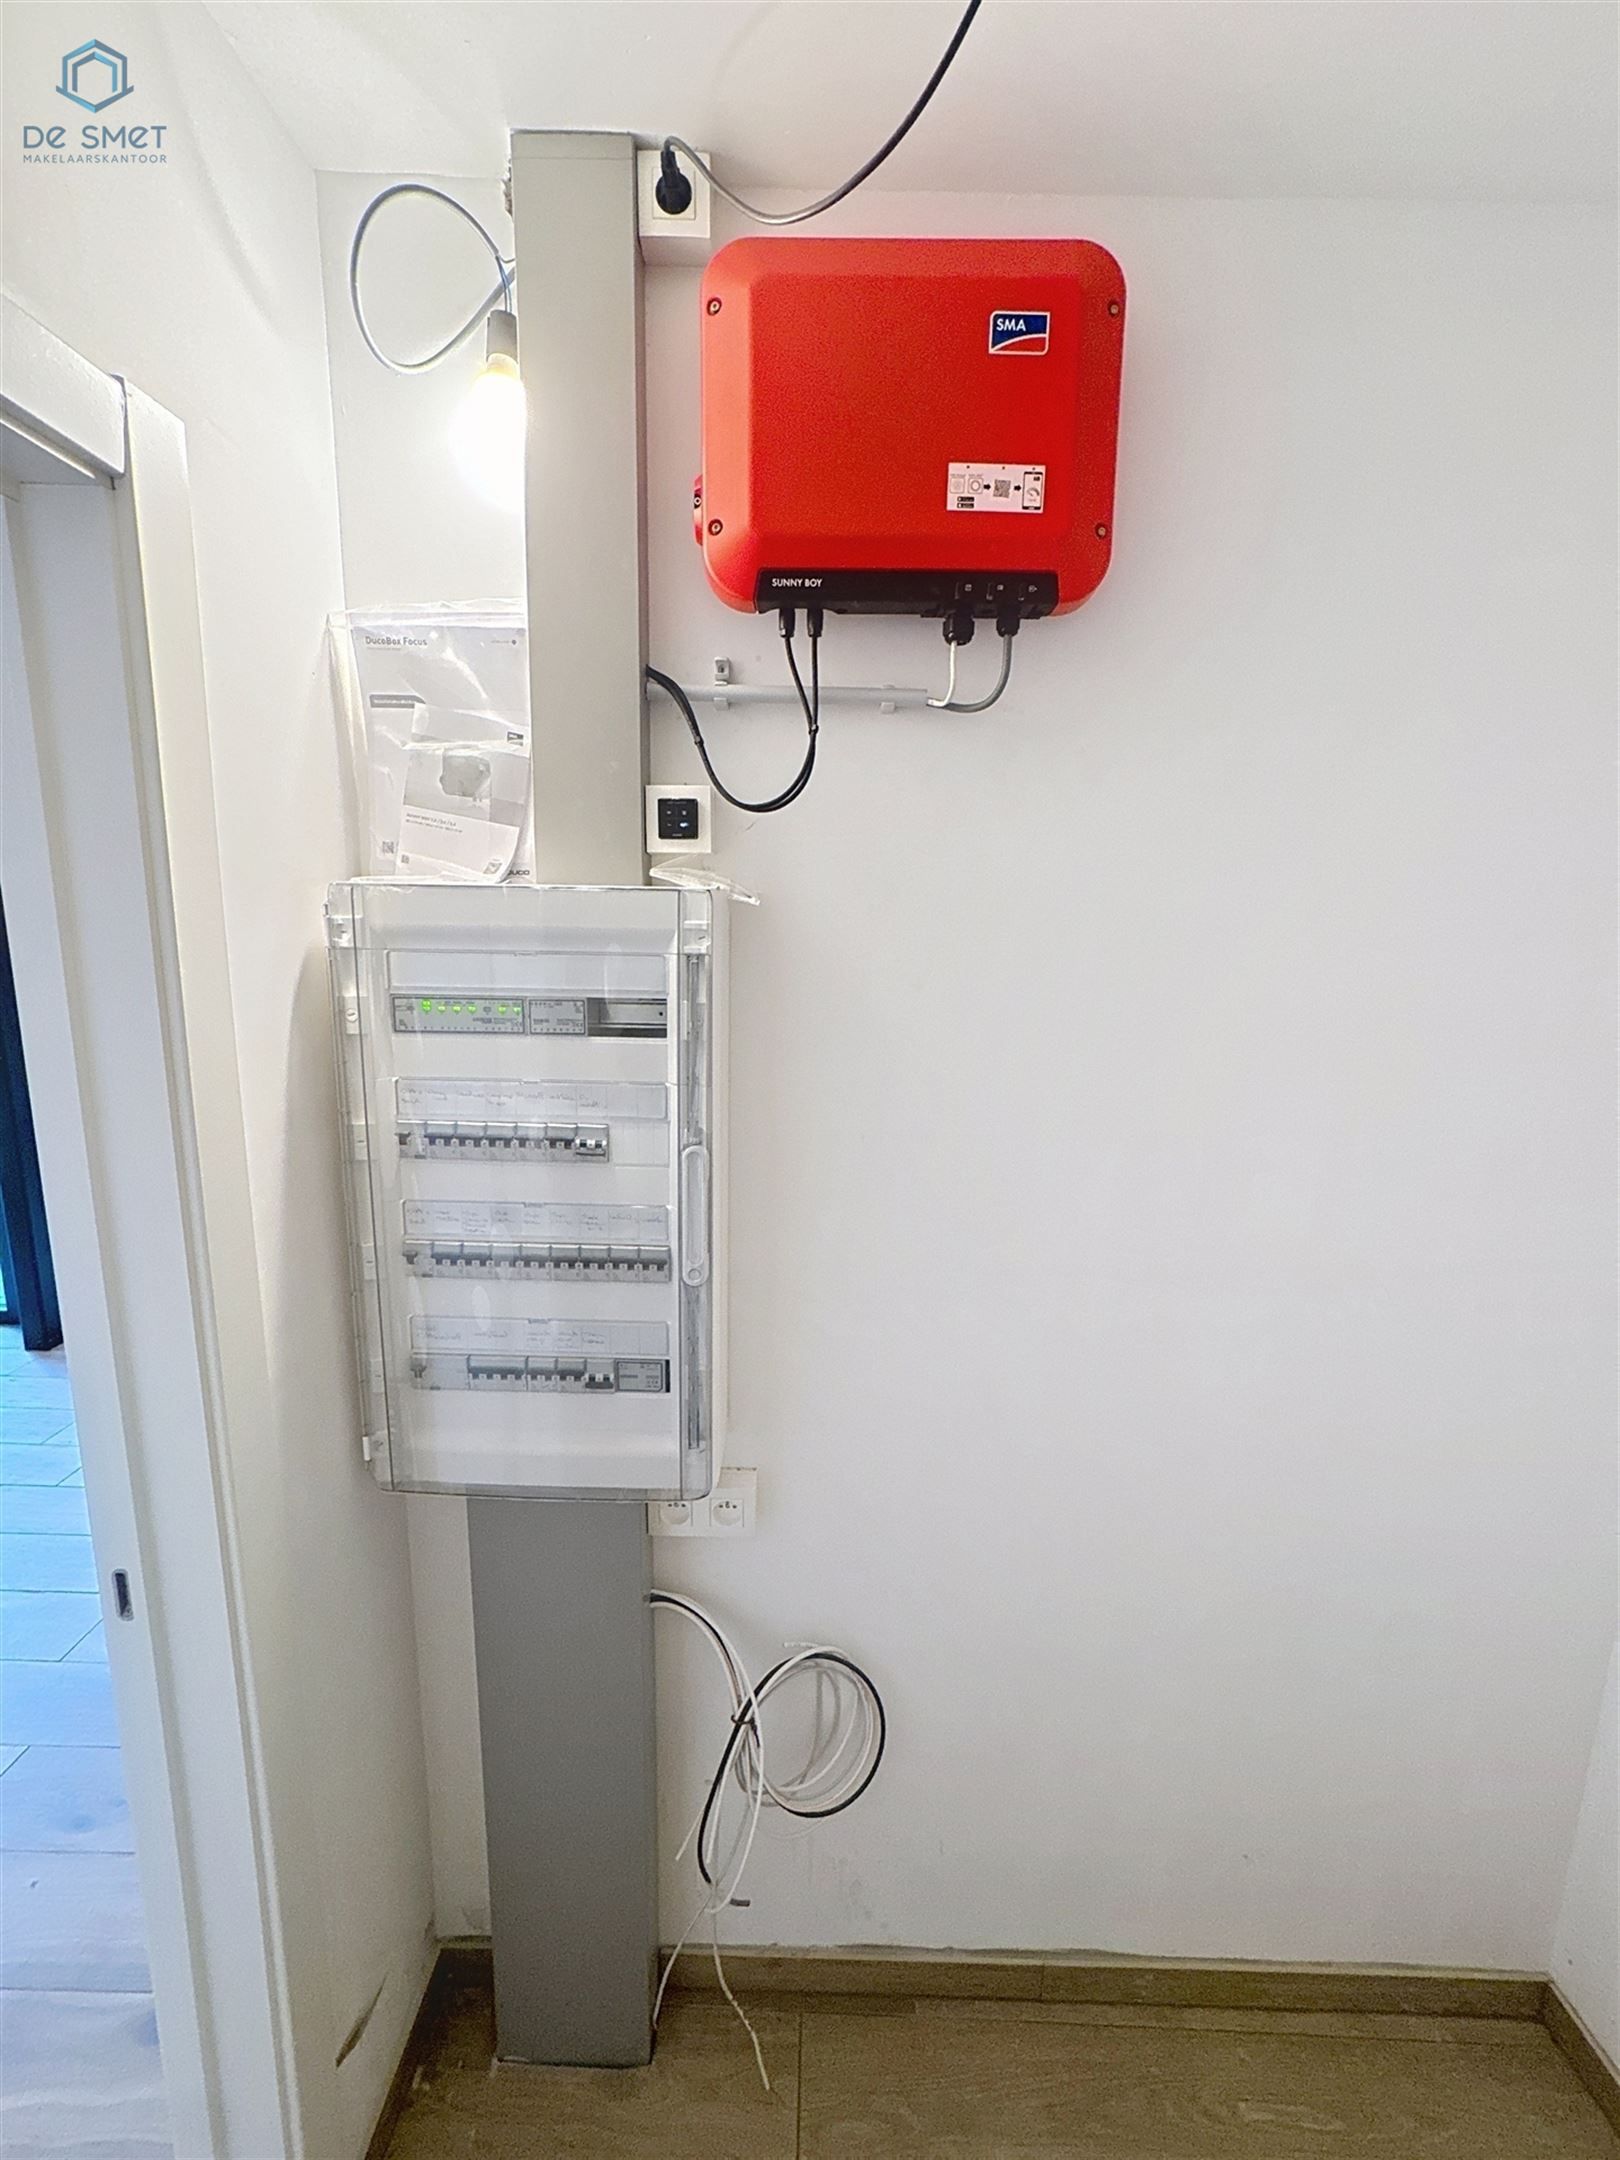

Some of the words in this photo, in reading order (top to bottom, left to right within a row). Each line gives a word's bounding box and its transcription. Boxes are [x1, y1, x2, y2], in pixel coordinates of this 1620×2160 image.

[996, 318, 1027, 332] SMA
[771, 578, 803, 588] SUNNY
[804, 578, 823, 588] BOY
[365, 636, 402, 646] DucoBox
[403, 636, 428, 646] Focus
